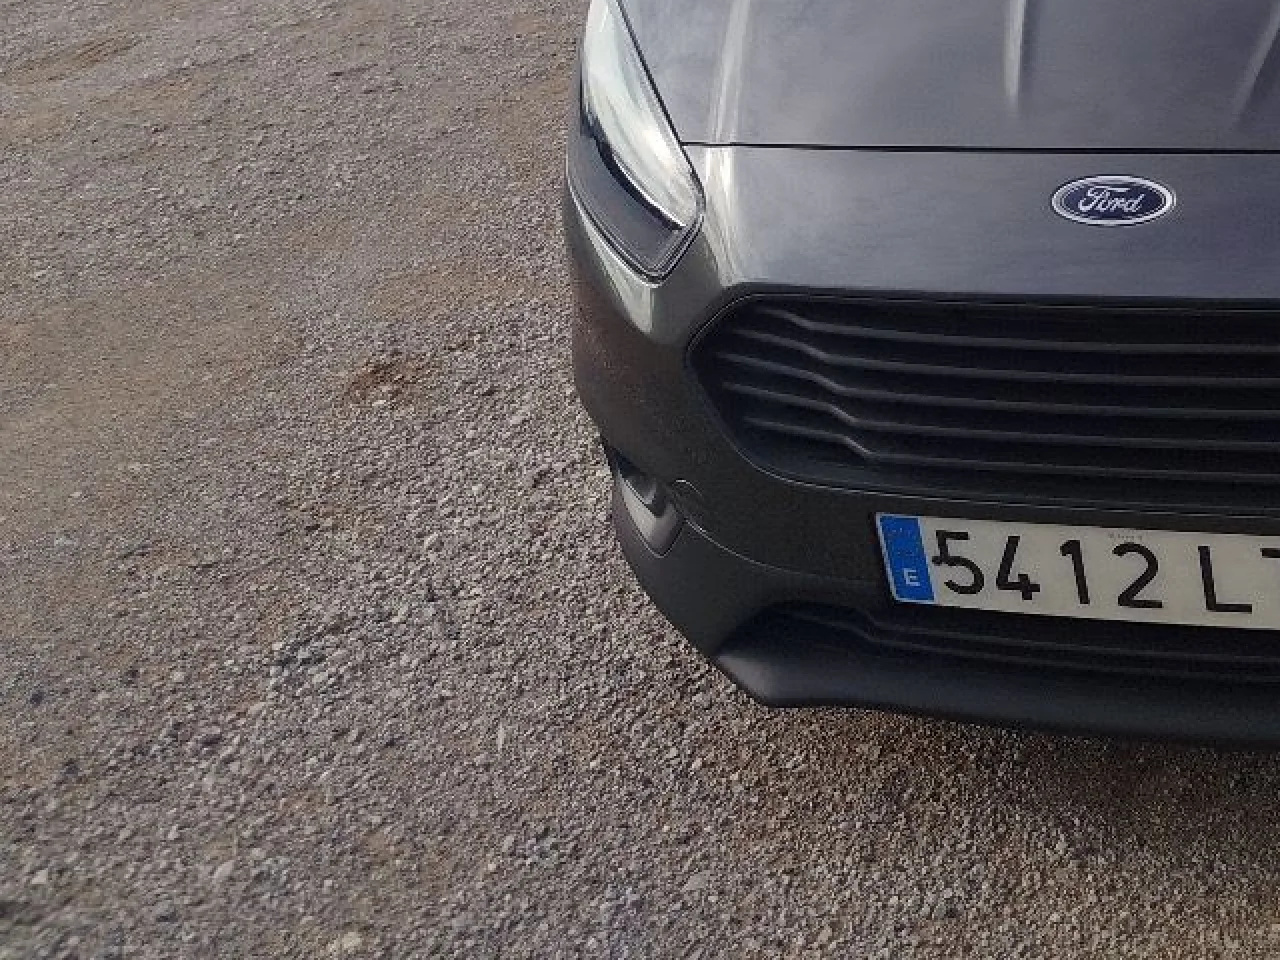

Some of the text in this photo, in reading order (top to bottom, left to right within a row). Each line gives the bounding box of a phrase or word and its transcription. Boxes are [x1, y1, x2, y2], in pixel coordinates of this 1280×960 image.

[1078, 185, 1145, 213] Ford
[903, 567, 921, 587] E
[931, 529, 1163, 609] 5412
